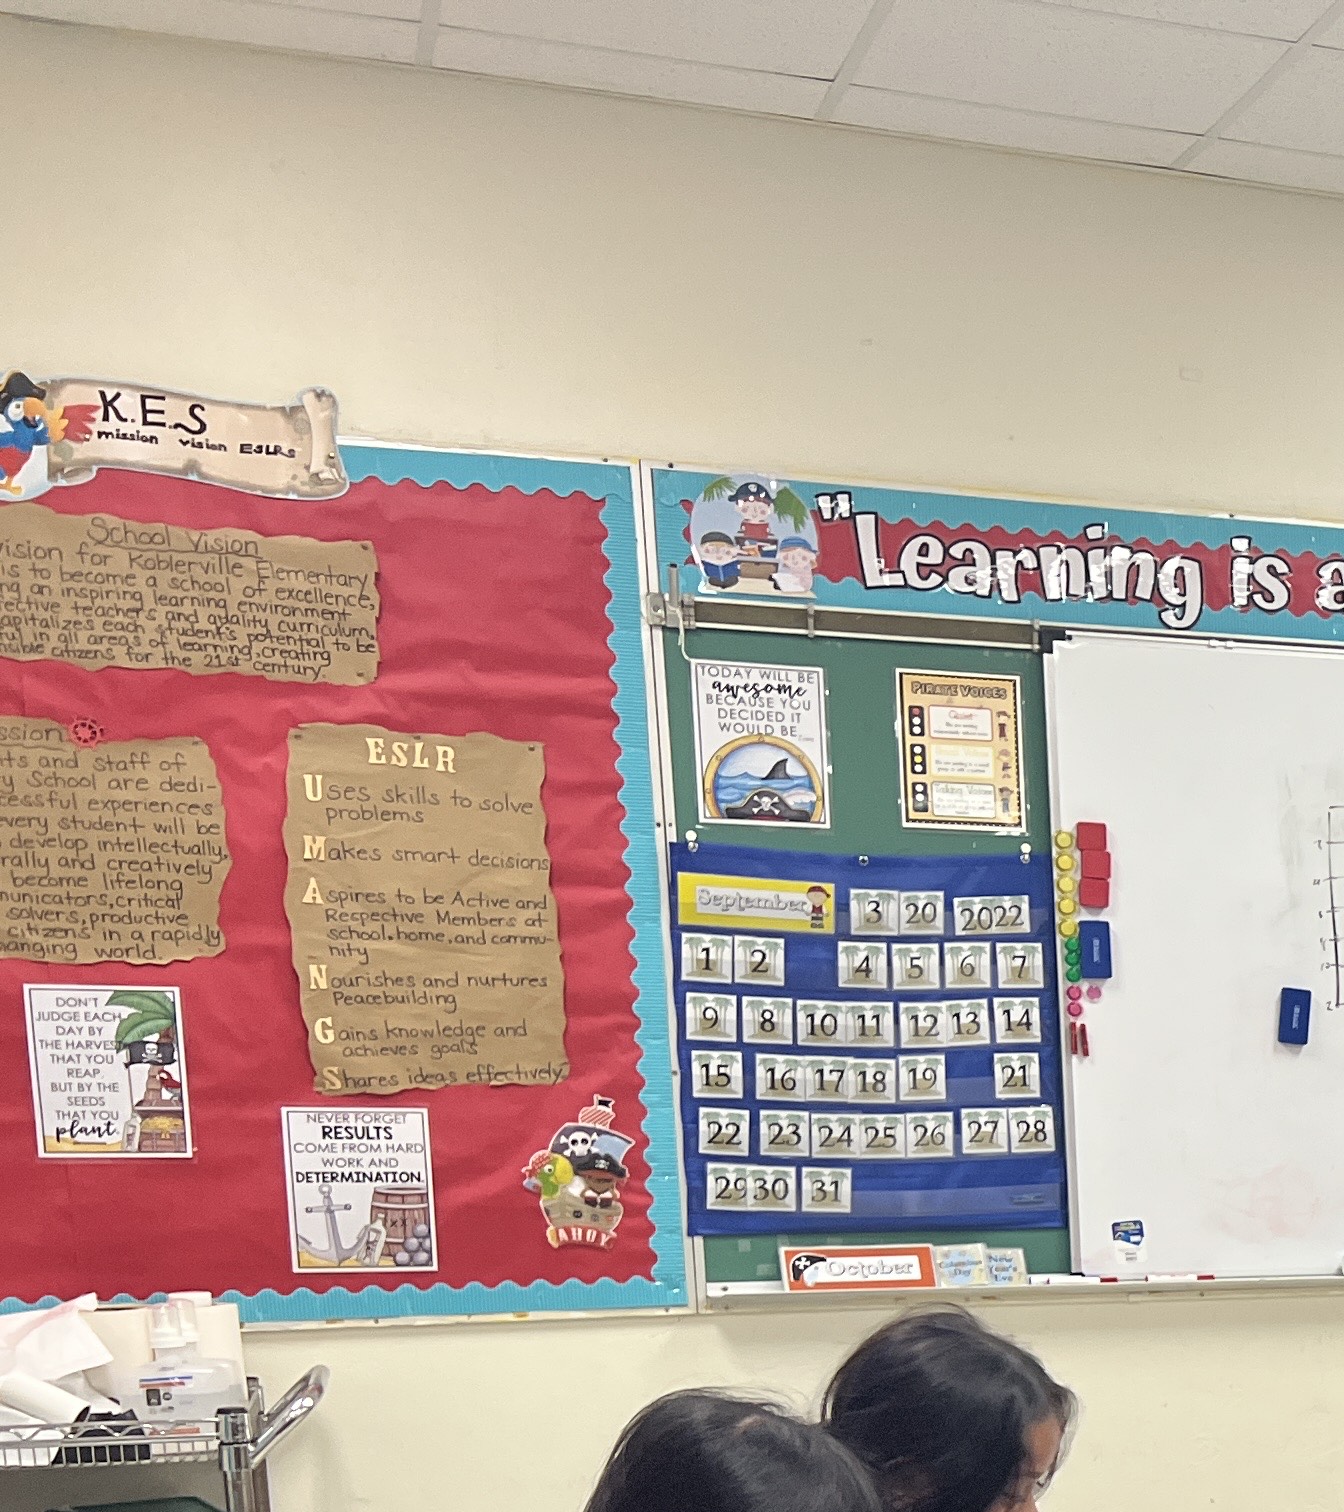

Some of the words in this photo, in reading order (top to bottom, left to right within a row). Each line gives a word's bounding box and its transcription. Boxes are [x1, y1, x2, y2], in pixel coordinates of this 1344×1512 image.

[97, 429, 158, 444] mission
[179, 438, 227, 452] vision
[88, 516, 170, 547] School
[188, 533, 259, 555] Vision
[76, 542, 110, 566] for
[128, 551, 244, 578] Koblerville
[255, 558, 368, 590] Elementary
[1229, 535, 1290, 613] is
[29, 563, 52, 580] to
[59, 561, 138, 588] become
[144, 574, 158, 588] a
[167, 575, 231, 596] school
[242, 578, 267, 599] of
[700, 665, 751, 680] TODAY
[758, 669, 791, 683] WILL
[798, 672, 816, 684] BE
[711, 679, 807, 699] awesome
[911, 681, 958, 697] PIRATE
[961, 685, 1007, 700] VOICES
[706, 693, 774, 709] BECAUSE
[779, 699, 811, 712] YOU
[717, 708, 783, 723] DECIDED
[791, 712, 801, 724] IT
[718, 721, 775, 736] WOULD
[365, 737, 457, 773] ESLR
[303, 774, 371, 803] Uses
[381, 785, 440, 806] skills
[450, 788, 472, 809] to
[478, 793, 534, 815] solve
[325, 805, 424, 826] problems
[302, 834, 382, 862] Makes
[392, 848, 461, 864] smart
[468, 849, 549, 871] decisions
[12, 872, 89, 889] become
[103, 873, 183, 900] lifelong
[698, 888, 809, 914] September
[866, 900, 883, 924] 3
[904, 902, 937, 925] 20
[960, 904, 1025, 932] 2022
[701, 947, 713, 971] 1
[750, 949, 769, 973] 2
[855, 955, 873, 978] 4
[908, 955, 924, 979] 5
[959, 954, 976, 978] 6
[1011, 955, 1028, 978] 7
[308, 964, 415, 990] Nourishes
[423, 971, 459, 988] and
[467, 971, 548, 988] nurtures
[56, 997, 98, 1007] DON'T
[333, 991, 457, 1014] Peacebuilding
[35, 1011, 80, 1022] JUDGE
[84, 1012, 122, 1022] EACH
[702, 1006, 719, 1031] 9
[760, 1009, 776, 1033] 8
[806, 1012, 838, 1036] 10
[856, 1014, 884, 1037] 11
[909, 1014, 940, 1037] 12
[952, 1012, 981, 1036] 13
[1001, 1008, 1033, 1032] 14
[56, 1026, 84, 1036] DAY
[88, 1026, 103, 1036] BY
[39, 1040, 62, 1050] THE
[65, 1040, 123, 1051] HARVEST
[50, 1054, 81, 1064] THAT
[86, 1054, 114, 1064] YOU
[51, 1082, 72, 1092] BUT
[77, 1082, 92, 1092] BY
[97, 1082, 119, 1092] THE
[701, 1063, 732, 1088] 15
[766, 1067, 797, 1092] 16
[814, 1068, 845, 1092] 17
[857, 1070, 887, 1094] 18
[908, 1066, 937, 1091] 19
[1001, 1064, 1030, 1088] 21
[67, 1096, 106, 1107] SEEDS
[56, 1110, 87, 1120] THAT
[90, 1110, 119, 1120] YOU
[306, 1112, 350, 1124] NEVER
[354, 1113, 407, 1124] FORGET
[321, 1125, 393, 1140] RESULTS
[707, 1120, 742, 1146] 22
[768, 1122, 801, 1146] 23
[818, 1124, 852, 1148] 24
[864, 1125, 897, 1149] 25
[913, 1123, 946, 1147] 26
[967, 1120, 999, 1144] 27
[1016, 1119, 1047, 1143] 28
[292, 1142, 338, 1153] COME
[341, 1142, 384, 1153] FROM
[386, 1143, 424, 1154] HARD
[321, 1157, 364, 1168] WORK
[368, 1157, 399, 1168] AND
[715, 1175, 747, 1200] 29
[753, 1177, 789, 1202] 30
[811, 1179, 841, 1202] 31
[558, 1226, 612, 1247] AHOY
[825, 1258, 914, 1278] October
